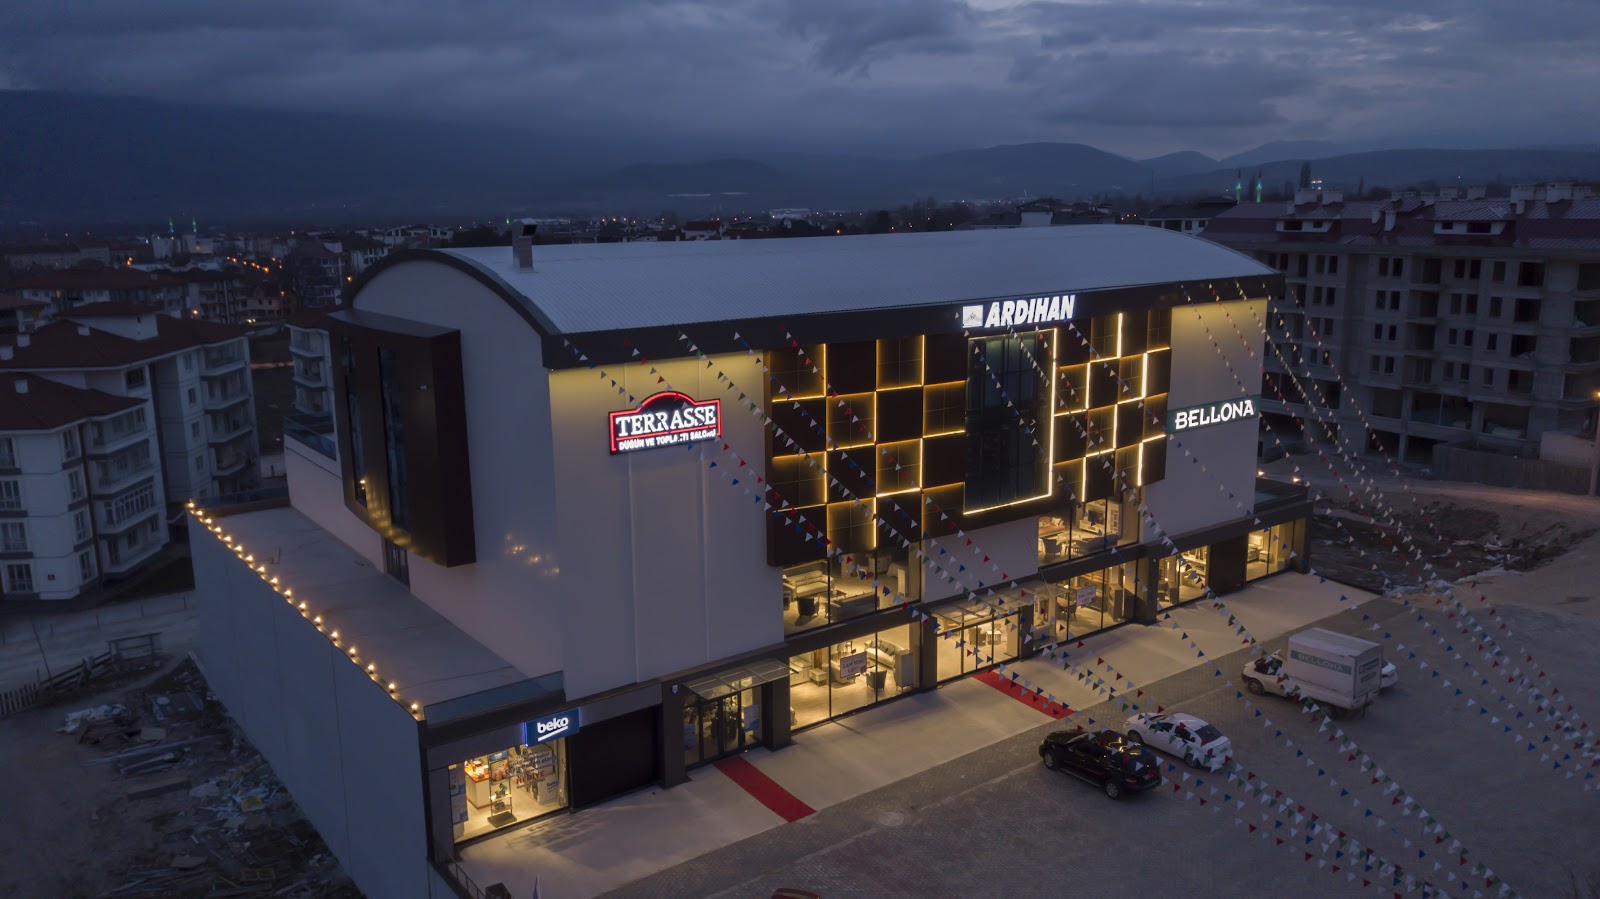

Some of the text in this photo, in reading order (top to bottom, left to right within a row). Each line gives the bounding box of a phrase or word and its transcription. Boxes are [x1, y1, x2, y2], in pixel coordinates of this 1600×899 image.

[984, 295, 1076, 328] ARDIHAN
[615, 405, 716, 437] TERRASSE
[1175, 399, 1255, 430] BELLONA
[645, 437, 655, 447] VE
[1298, 653, 1344, 672] BELLONA
[537, 717, 569, 734] beko
